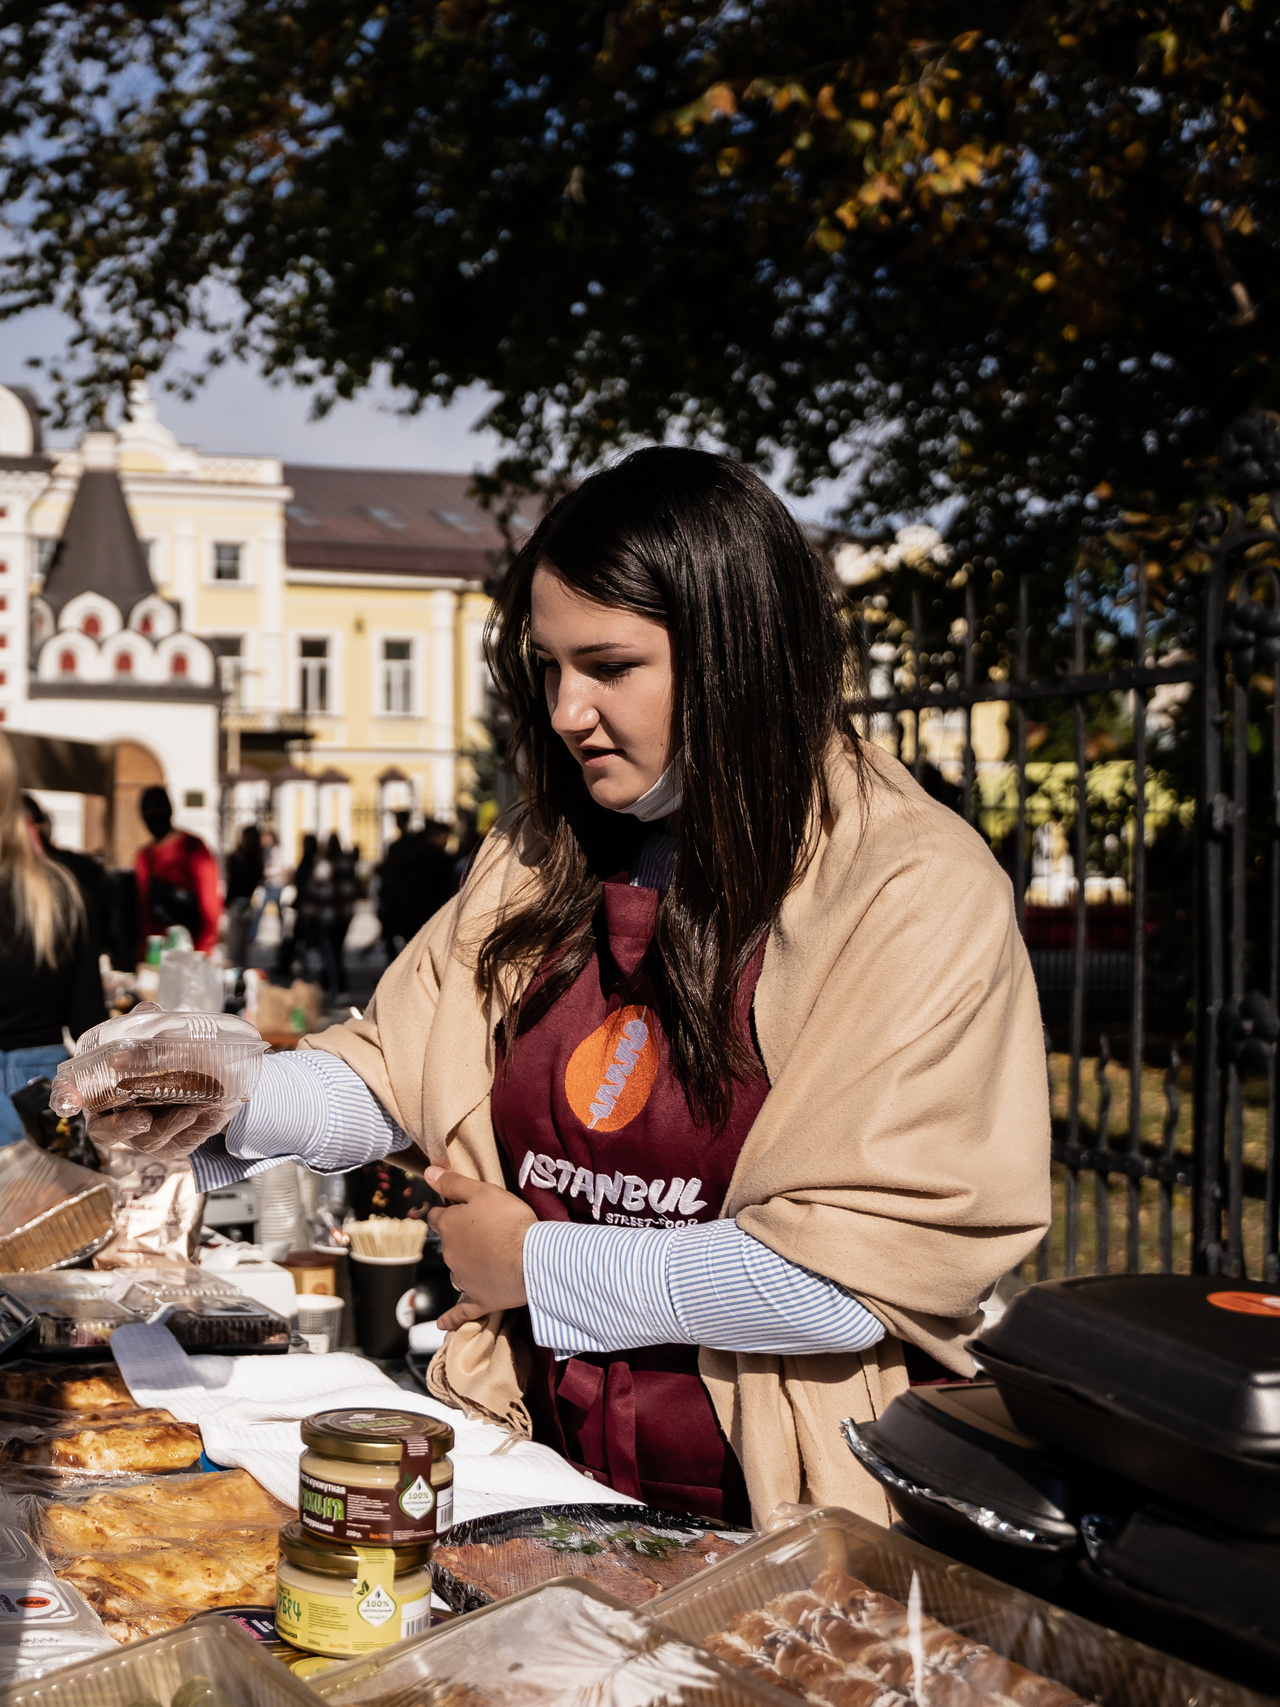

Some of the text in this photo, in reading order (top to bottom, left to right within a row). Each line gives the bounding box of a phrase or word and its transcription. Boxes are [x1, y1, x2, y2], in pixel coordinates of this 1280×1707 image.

[519, 1150, 708, 1221] ISTANBUL
[408, 1492, 429, 1500] 100%
[278, 1592, 302, 1622] РБЕЧ
[366, 1600, 390, 1608] 100%
